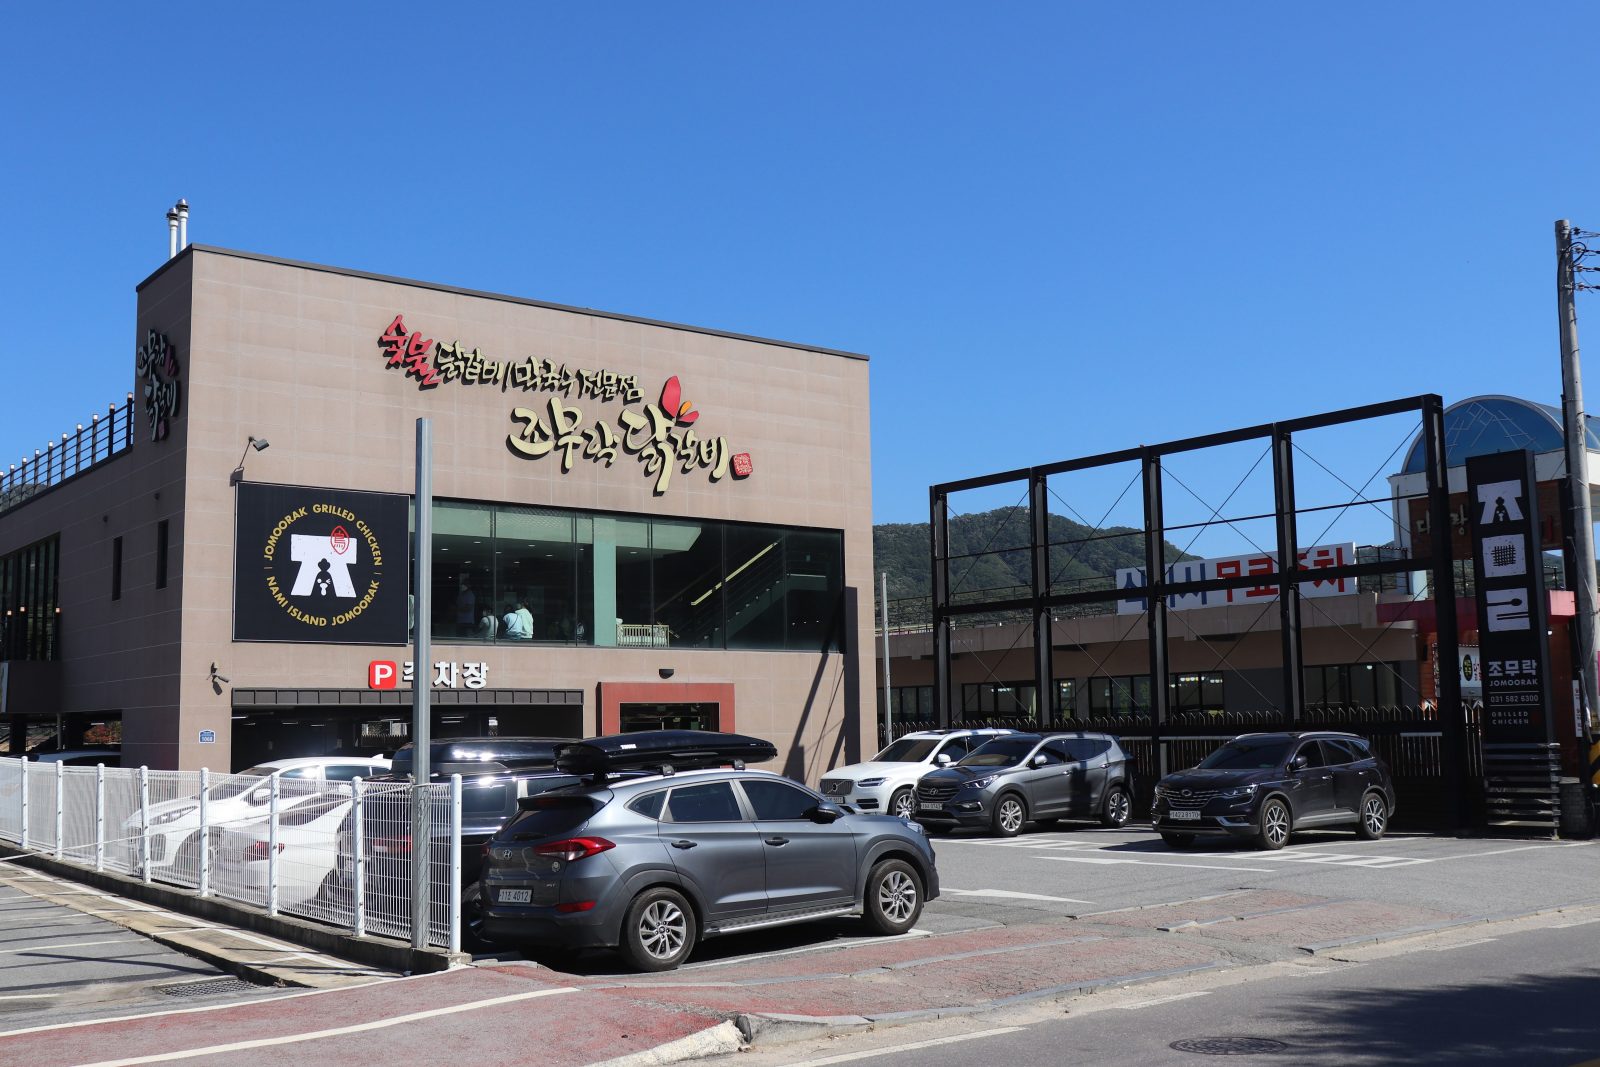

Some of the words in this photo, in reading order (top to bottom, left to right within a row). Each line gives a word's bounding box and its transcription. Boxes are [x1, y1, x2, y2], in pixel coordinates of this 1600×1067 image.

[264, 506, 308, 561] JOMOORAK
[312, 503, 355, 522] GRILLED
[356, 520, 382, 566] CHICKEN
[267, 576, 288, 607] NAMI
[287, 605, 327, 626] ISLAND
[331, 580, 380, 626] JOMOORAK
[1488, 659, 1538, 677] 조무락
[1489, 679, 1538, 687] JOMOORAK
[1505, 695, 1519, 703] 582
[513, 891, 529, 901] 4012
